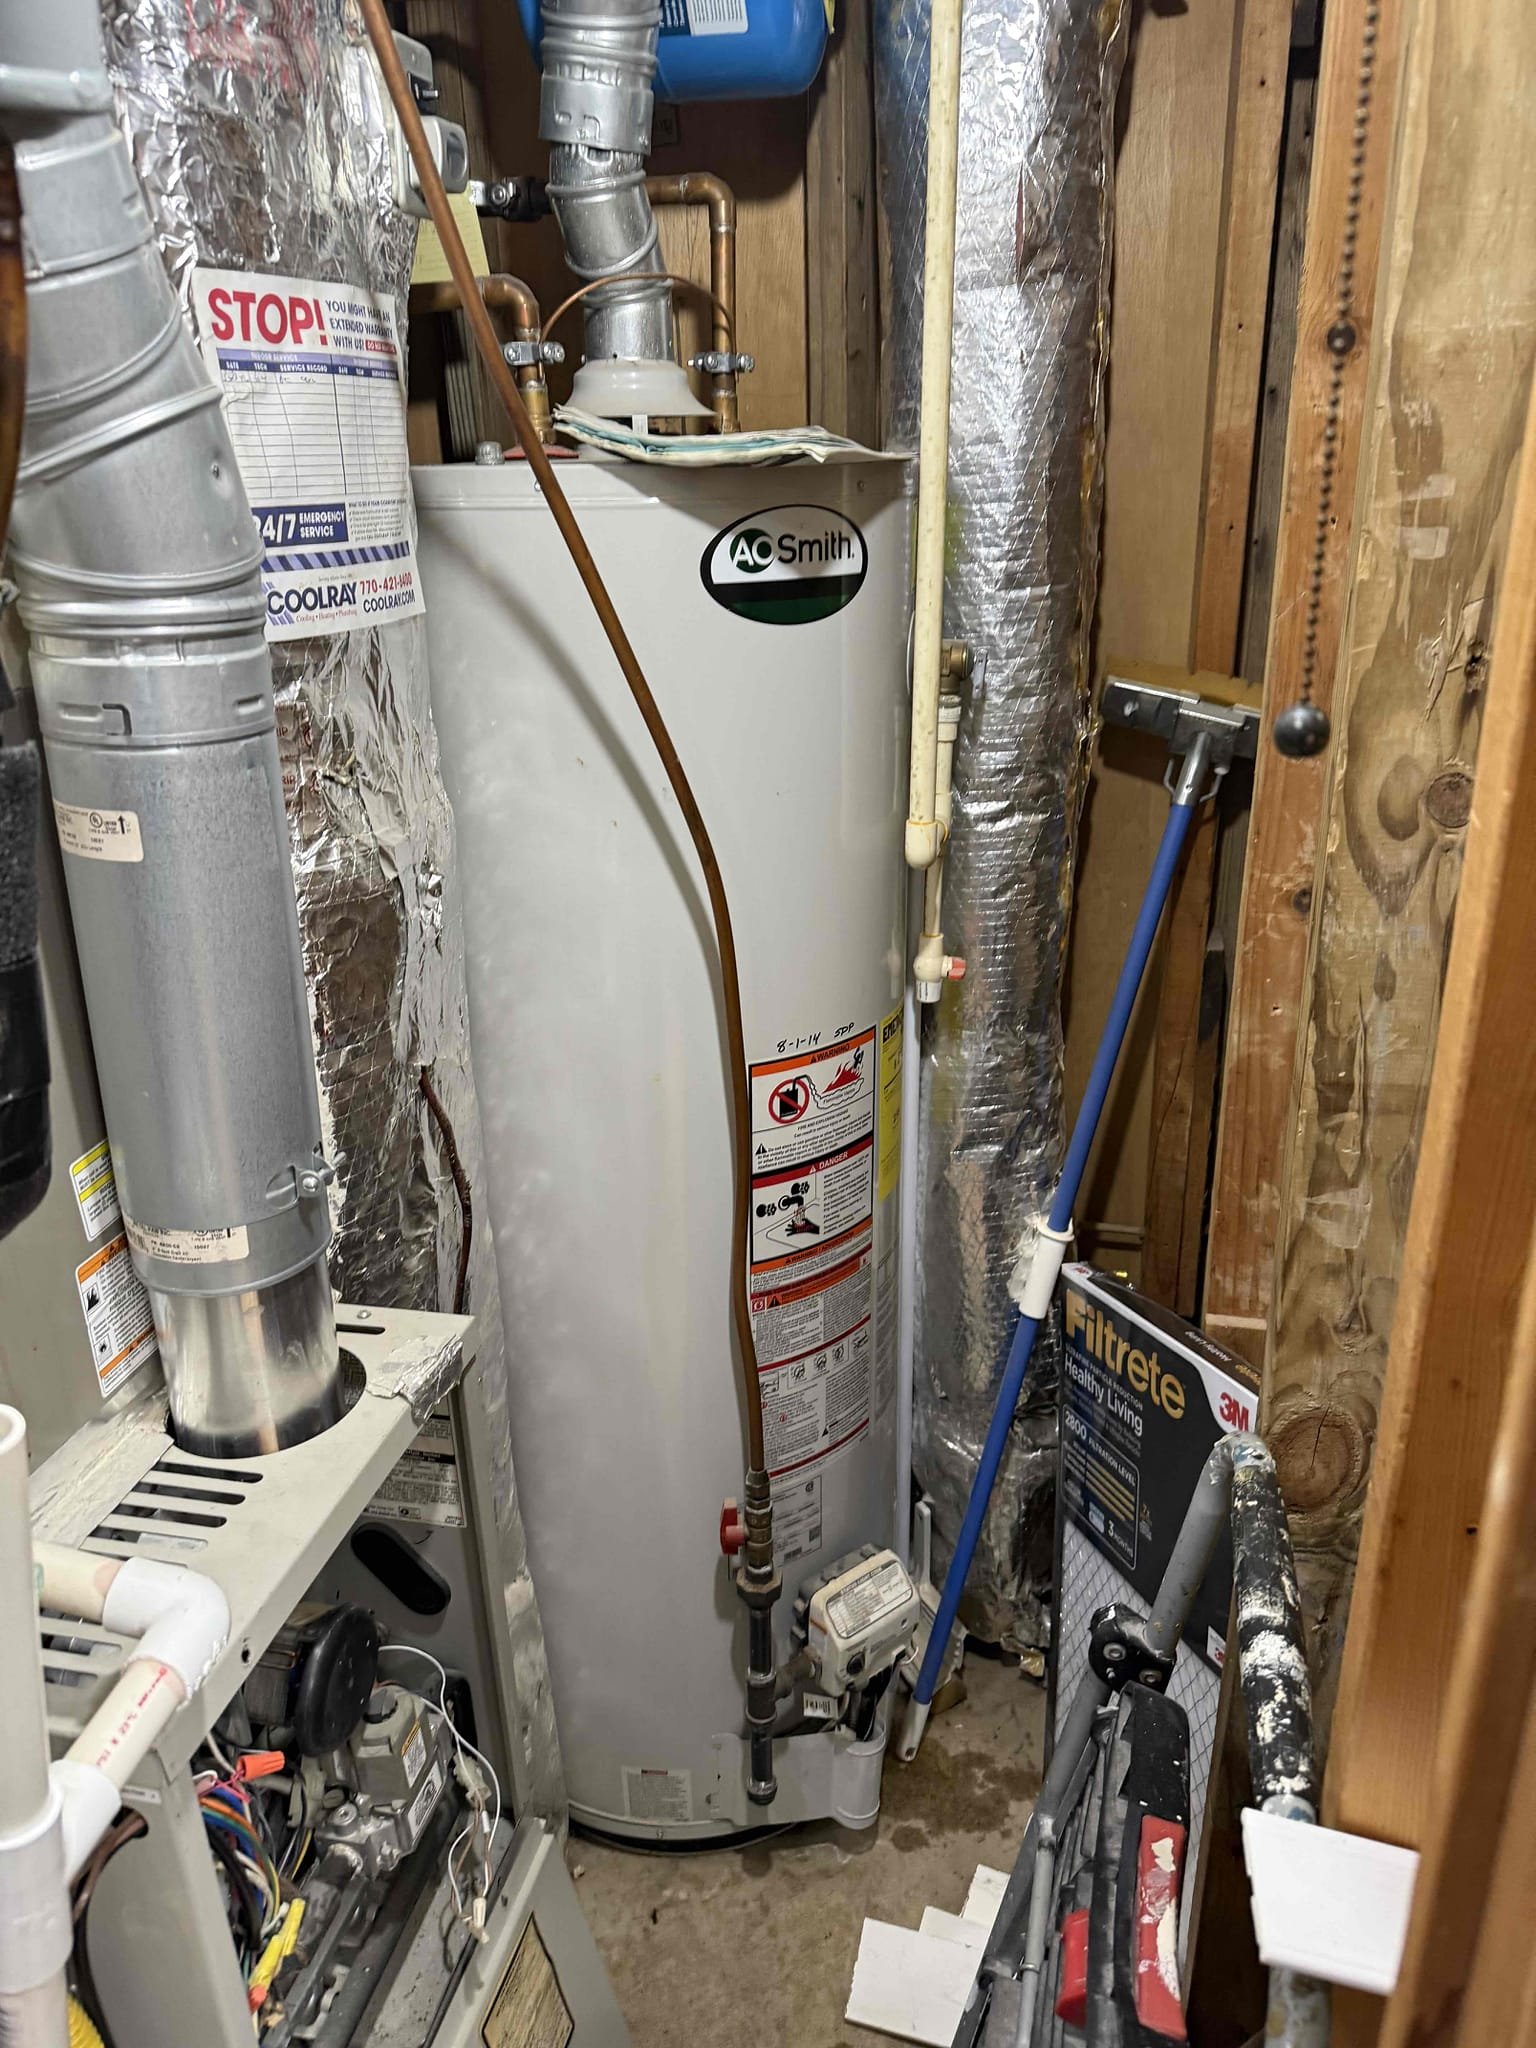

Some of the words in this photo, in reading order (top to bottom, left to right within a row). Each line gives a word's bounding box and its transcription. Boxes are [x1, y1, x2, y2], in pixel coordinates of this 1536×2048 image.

[208, 287, 328, 346] STOP!
[325, 300, 346, 313] YOU
[329, 317, 364, 334] EXTENDED
[333, 335, 353, 350] WITH
[299, 510, 345, 524] EMERGENCY
[300, 525, 334, 538] SERVICE
[777, 530, 852, 564] Smith
[267, 581, 357, 615] COOLRAY
[363, 588, 416, 613] COOLRAY.COM
[776, 1031, 822, 1053] 8-1-14
[815, 1043, 851, 1062] WARNING
[818, 1151, 849, 1169] DANGER
[1066, 1288, 1185, 1420] Filtrete
[1064, 1353, 1104, 1404] Healthy
[1107, 1387, 1143, 1437] Living
[1219, 1391, 1249, 1432] 3M
[1065, 1410, 1087, 1441] 2800
[1088, 1436, 1118, 1470] FILTRATION
[1118, 1464, 1136, 1487] LEVEL
[1107, 1519, 1115, 1538] 3
